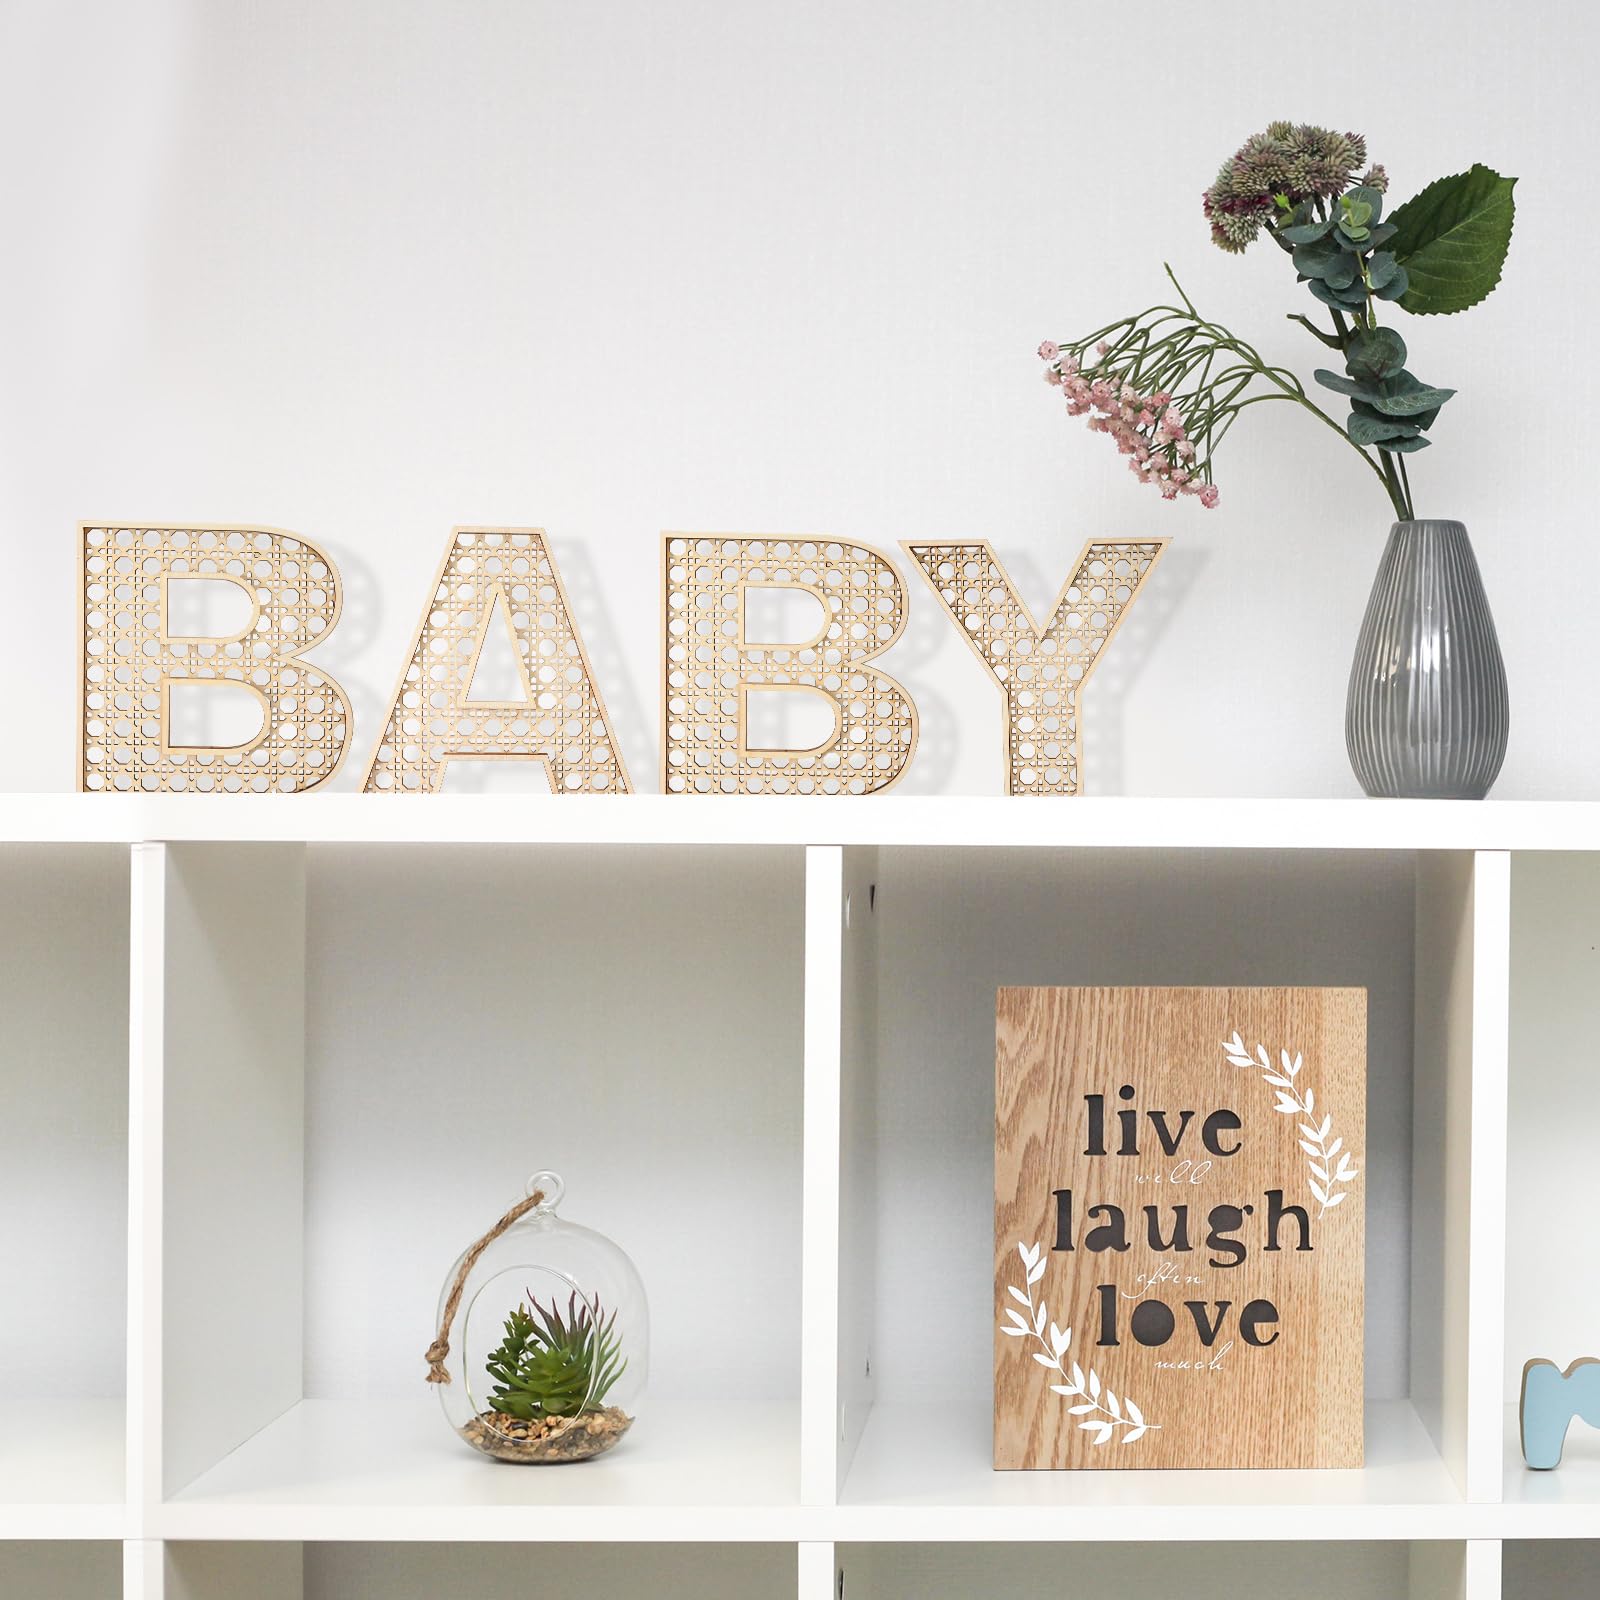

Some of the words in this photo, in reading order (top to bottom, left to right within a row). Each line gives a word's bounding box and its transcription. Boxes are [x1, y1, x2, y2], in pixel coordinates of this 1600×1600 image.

[77, 520, 1174, 795] BABY
[1083, 1084, 1243, 1157] live
[1134, 1159, 1211, 1184] well
[1051, 1188, 1314, 1269] laugh
[1121, 1261, 1205, 1300] often
[1095, 1284, 1280, 1348] love
[1154, 1341, 1233, 1370] much
